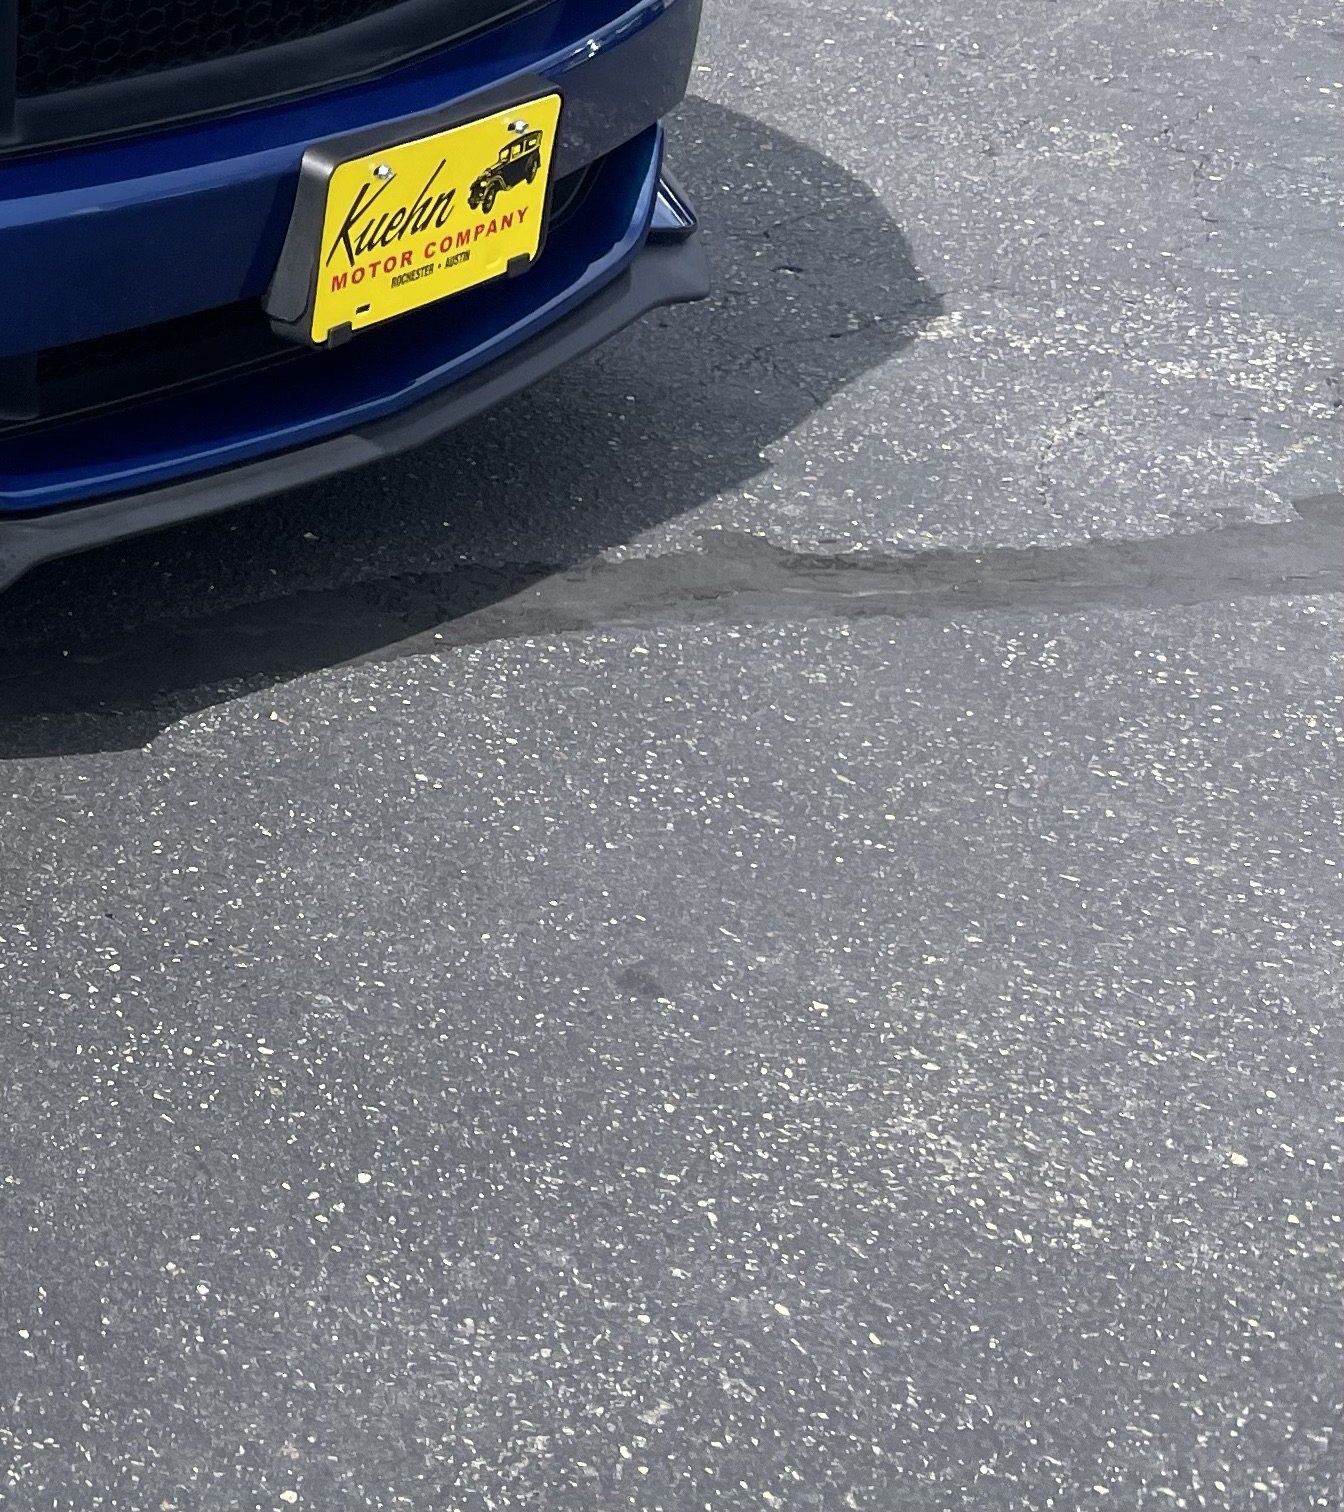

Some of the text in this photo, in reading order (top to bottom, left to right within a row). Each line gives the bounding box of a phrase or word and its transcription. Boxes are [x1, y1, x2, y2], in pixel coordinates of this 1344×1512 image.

[325, 158, 457, 268] Kuehn
[331, 205, 530, 293] MOTOR COMPANY
[390, 249, 471, 289] ROCHESTER AUSTIN
